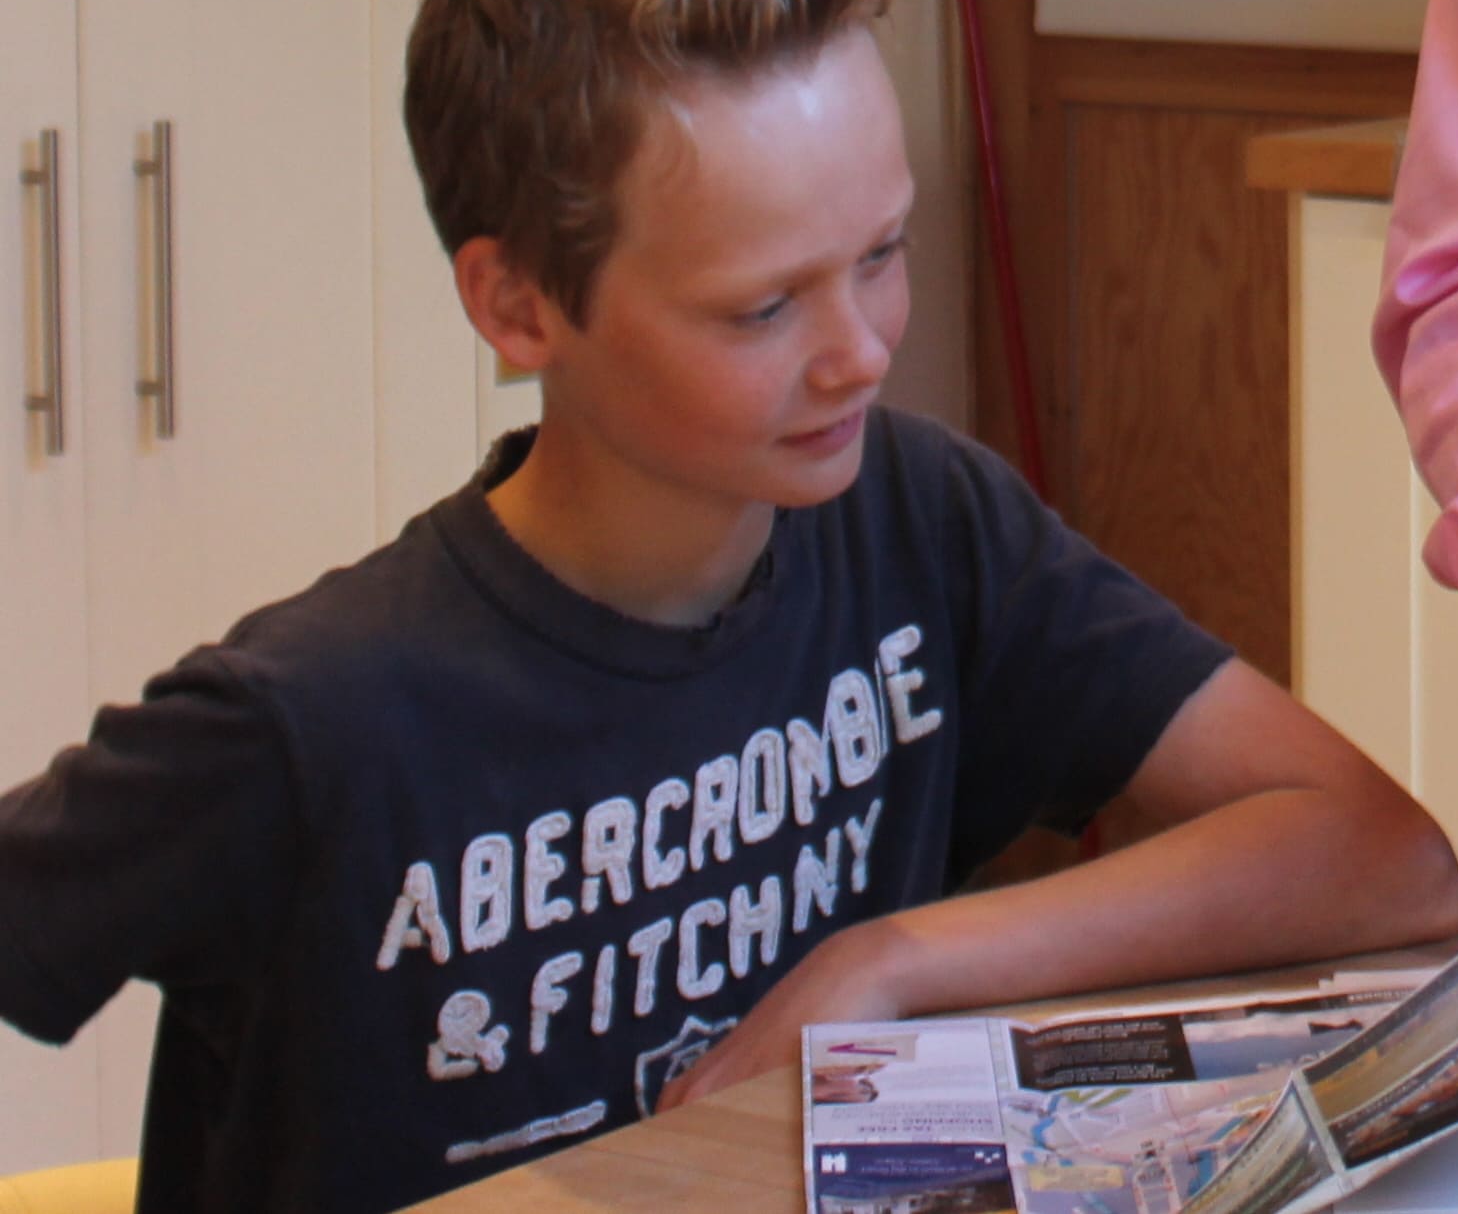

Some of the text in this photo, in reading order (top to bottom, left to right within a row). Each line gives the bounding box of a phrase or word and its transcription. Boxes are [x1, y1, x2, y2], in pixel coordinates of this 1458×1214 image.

[375, 623, 943, 971] ABERCROMBE
[426, 797, 883, 1082] & FITCH NY
